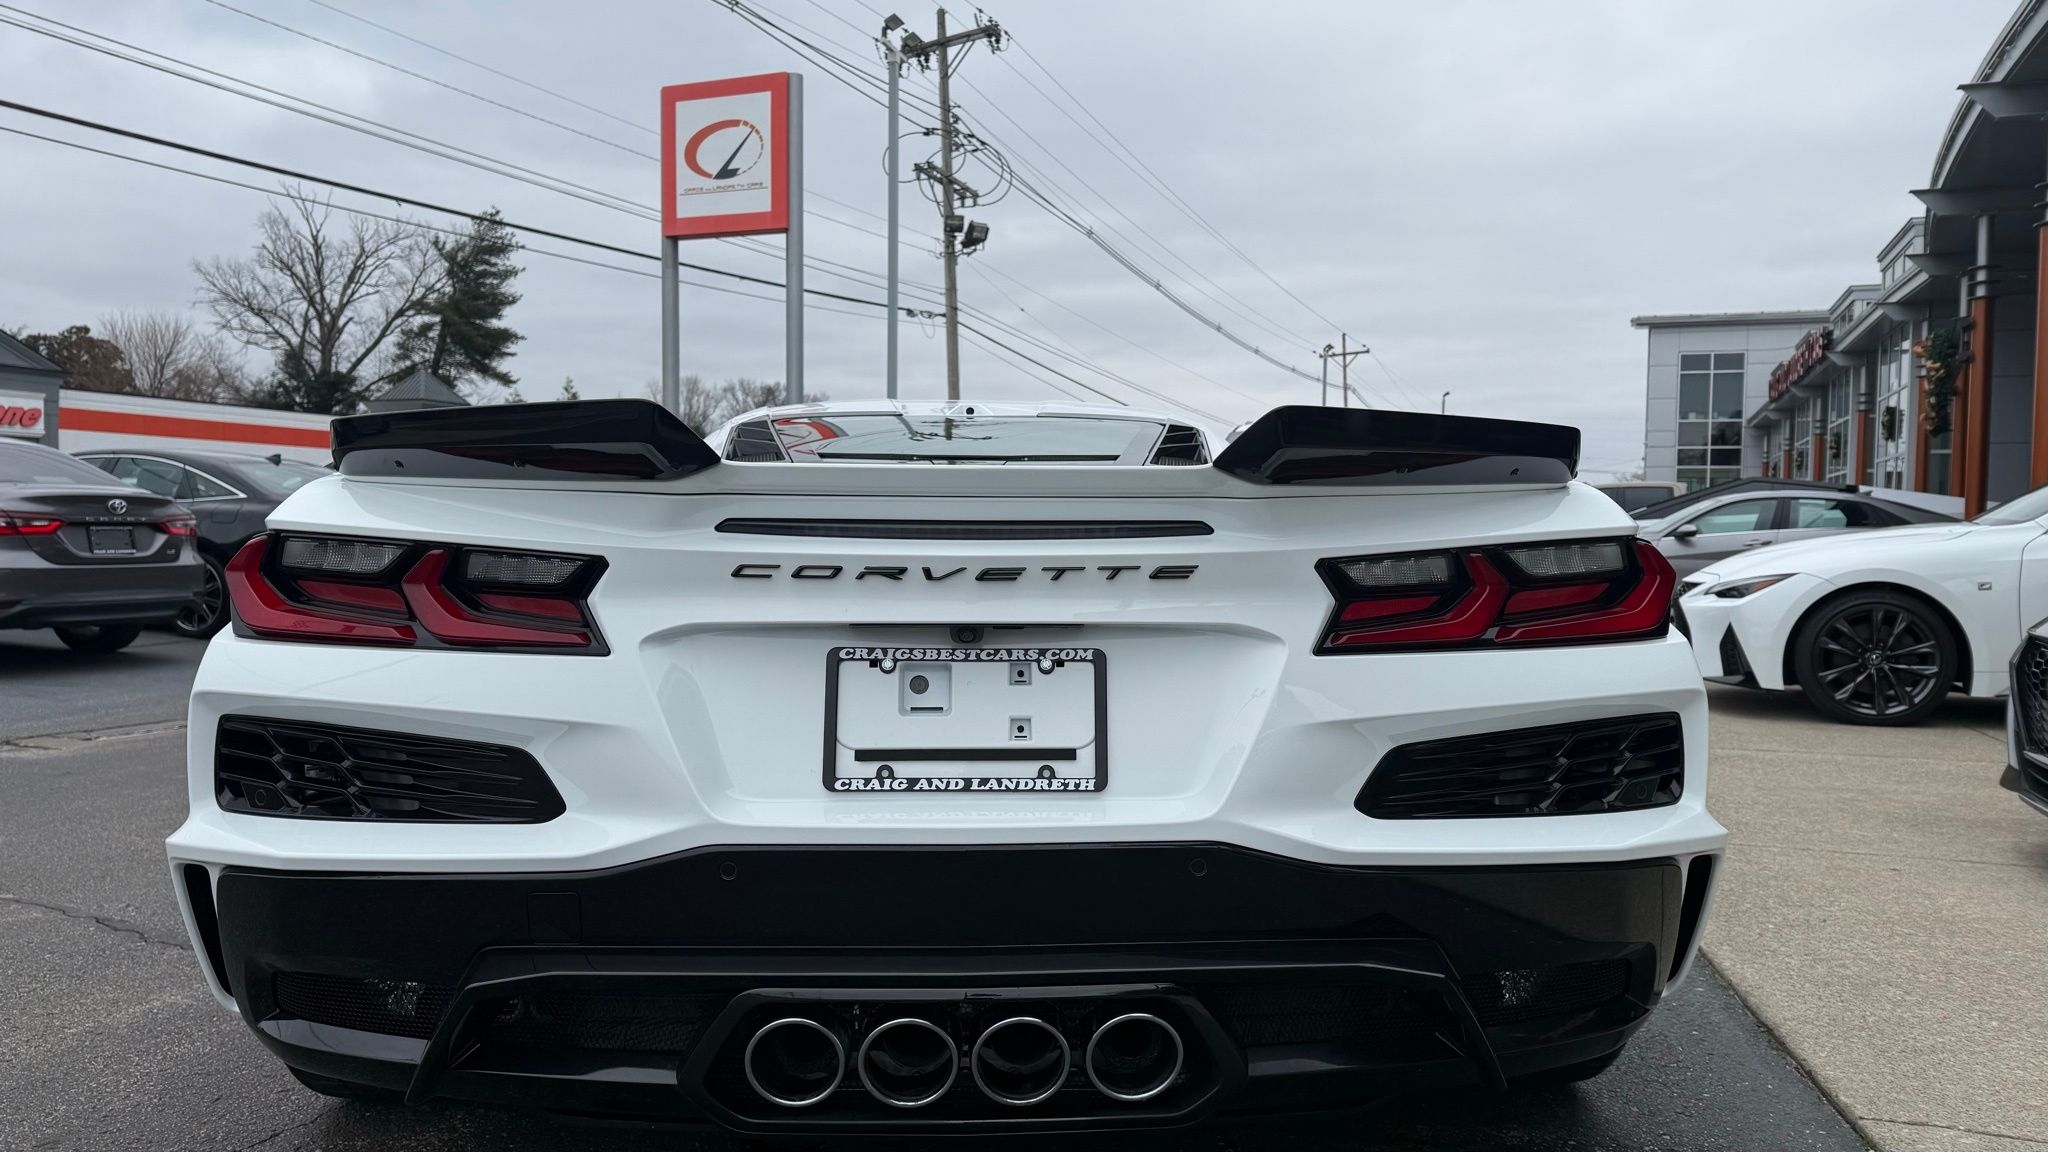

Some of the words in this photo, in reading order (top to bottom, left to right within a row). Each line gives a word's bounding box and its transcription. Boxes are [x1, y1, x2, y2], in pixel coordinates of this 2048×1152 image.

[0, 405, 42, 427] ne
[731, 564, 1199, 581] CORVETTE
[838, 648, 1094, 661] CRAIGSBESTCARS.COM
[834, 778, 908, 791] CRAIG
[913, 778, 965, 791] AND
[970, 778, 1096, 791] LANDRETH
